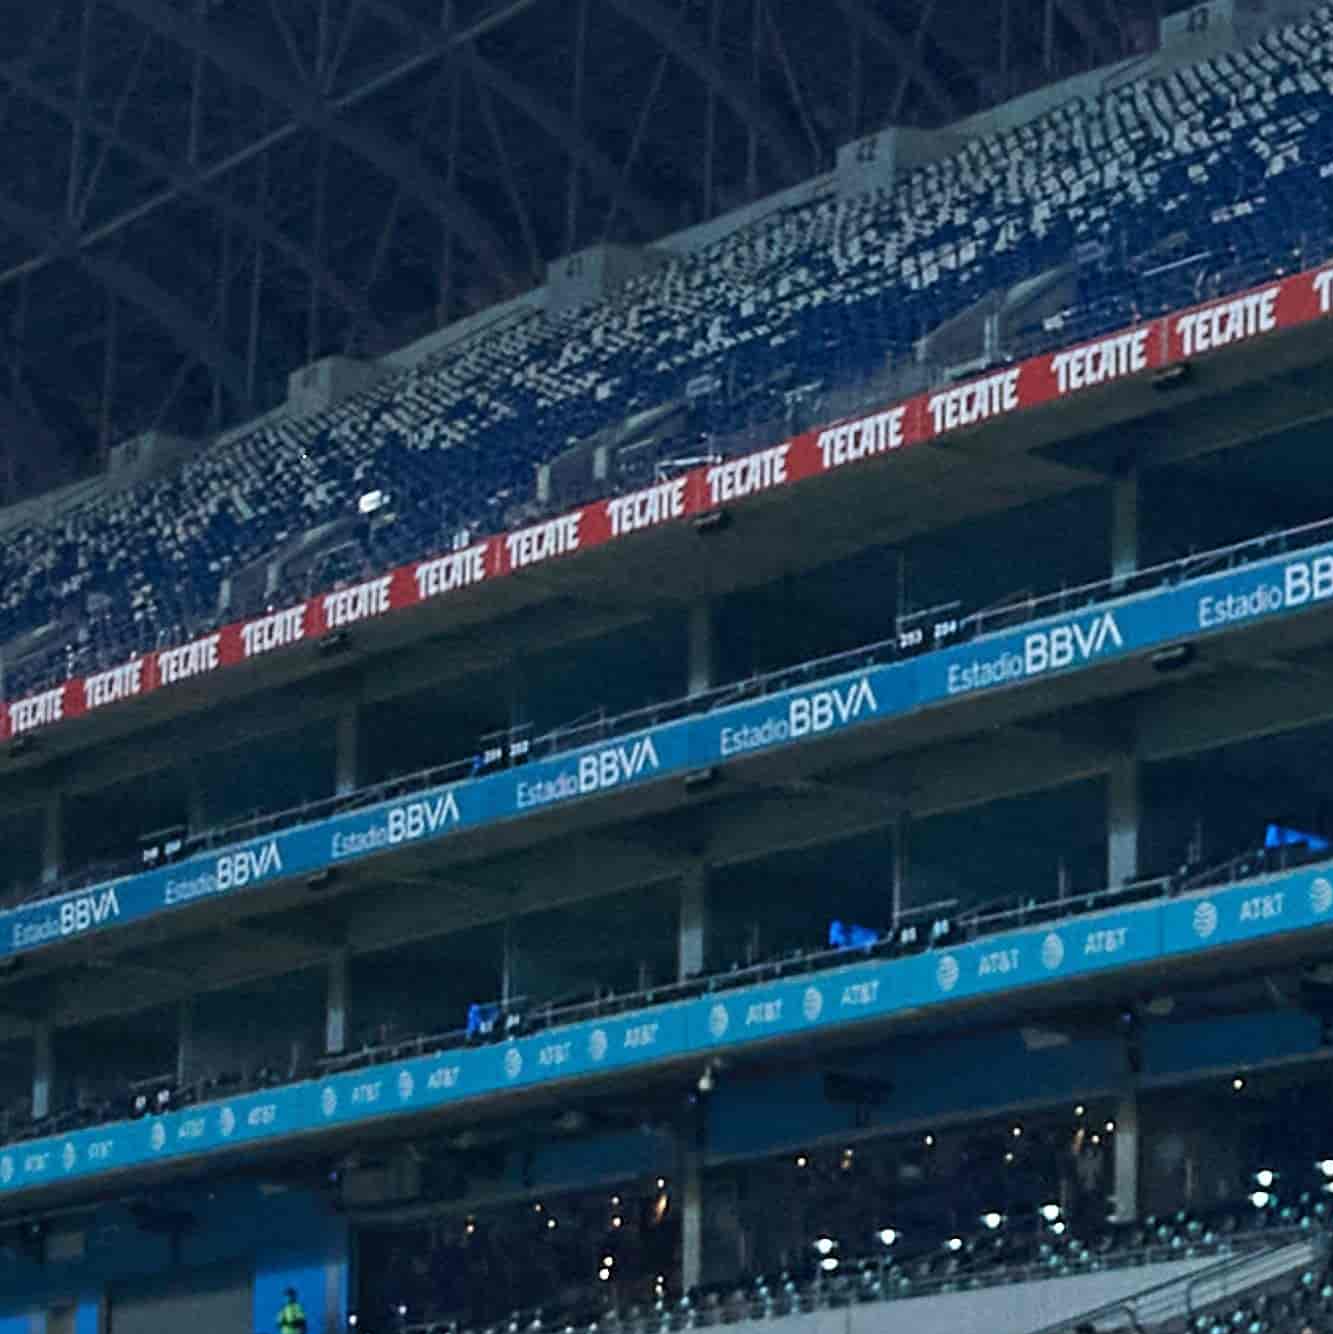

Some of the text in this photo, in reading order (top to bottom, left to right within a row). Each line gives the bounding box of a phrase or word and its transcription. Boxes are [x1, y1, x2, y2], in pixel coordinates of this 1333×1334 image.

[8, 688, 64, 735] TECATE
[84, 660, 143, 708] TECATE
[158, 634, 220, 685] TECATE
[240, 605, 307, 657] TECATE
[322, 576, 394, 629] TECATE
[415, 544, 488, 599] TECATE
[506, 512, 584, 569] TECATE
[606, 478, 688, 536] TECATE
[706, 444, 791, 503] TECATE
[818, 407, 905, 469] TECATE
[929, 368, 1021, 434] TECATE
[1051, 328, 1149, 393] TECATE
[1176, 287, 1280, 356] TECATE
[1199, 579, 1286, 628] Estadio
[948, 610, 1123, 694] Estadio BBVA
[720, 677, 877, 756] Estadio BBVA
[516, 735, 659, 808] Estadio BBVA
[331, 791, 460, 858] Estadio BBVA
[216, 840, 282, 890] BBVA
[60, 888, 120, 935] BBVA
[427, 1066, 461, 1090] AT&T
[538, 1042, 572, 1066] AT&T
[624, 1024, 659, 1049] AT&T
[746, 999, 784, 1026] AT&T
[840, 979, 880, 1007] AT&T
[977, 947, 1020, 976] AT&T
[1083, 927, 1129, 955] AT&T
[1239, 892, 1285, 922] AT&T
